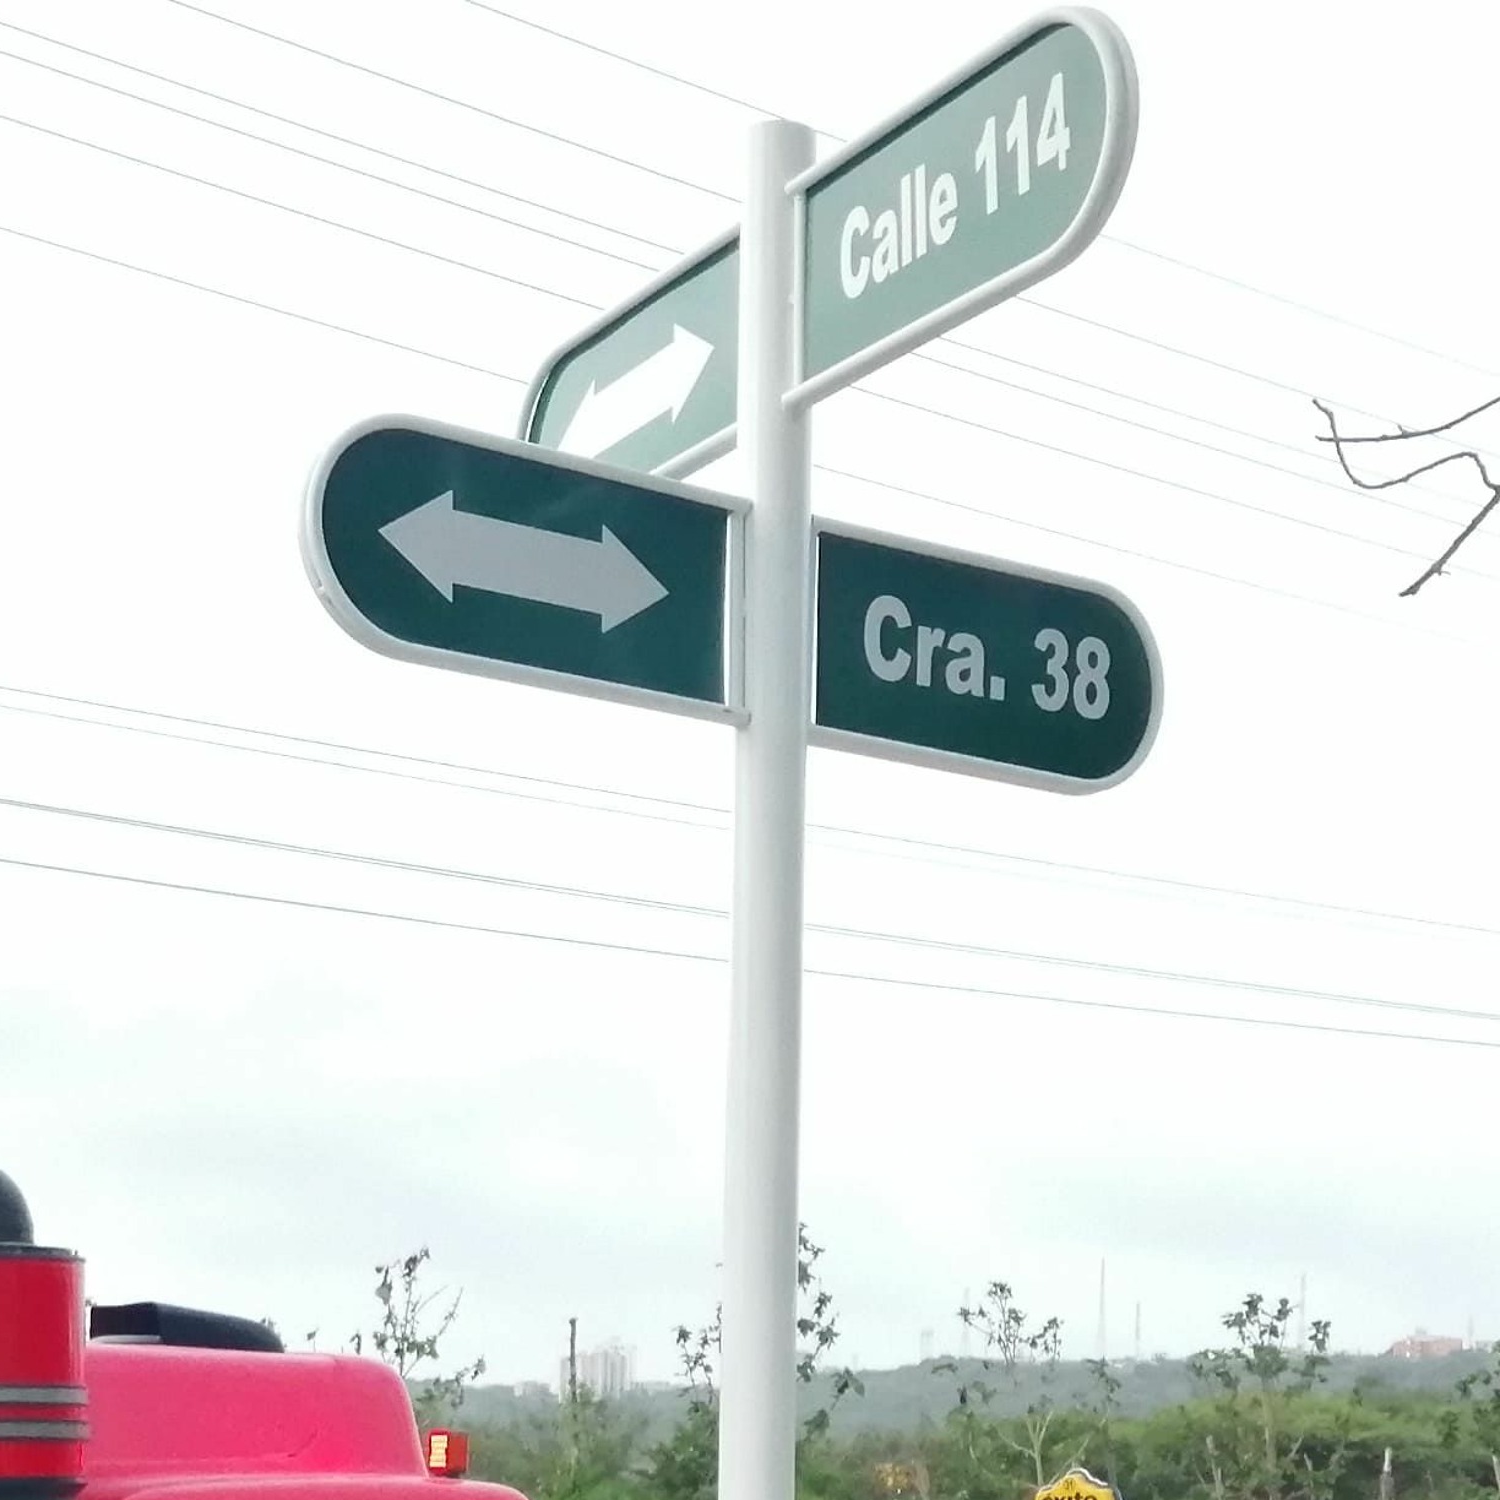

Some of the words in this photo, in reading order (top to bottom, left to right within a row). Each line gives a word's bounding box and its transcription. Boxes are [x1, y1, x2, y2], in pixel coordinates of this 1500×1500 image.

[840, 163, 958, 299] Calle
[974, 72, 1071, 215] 114
[863, 595, 1005, 701] Cra.
[1031, 628, 1111, 720] 38
